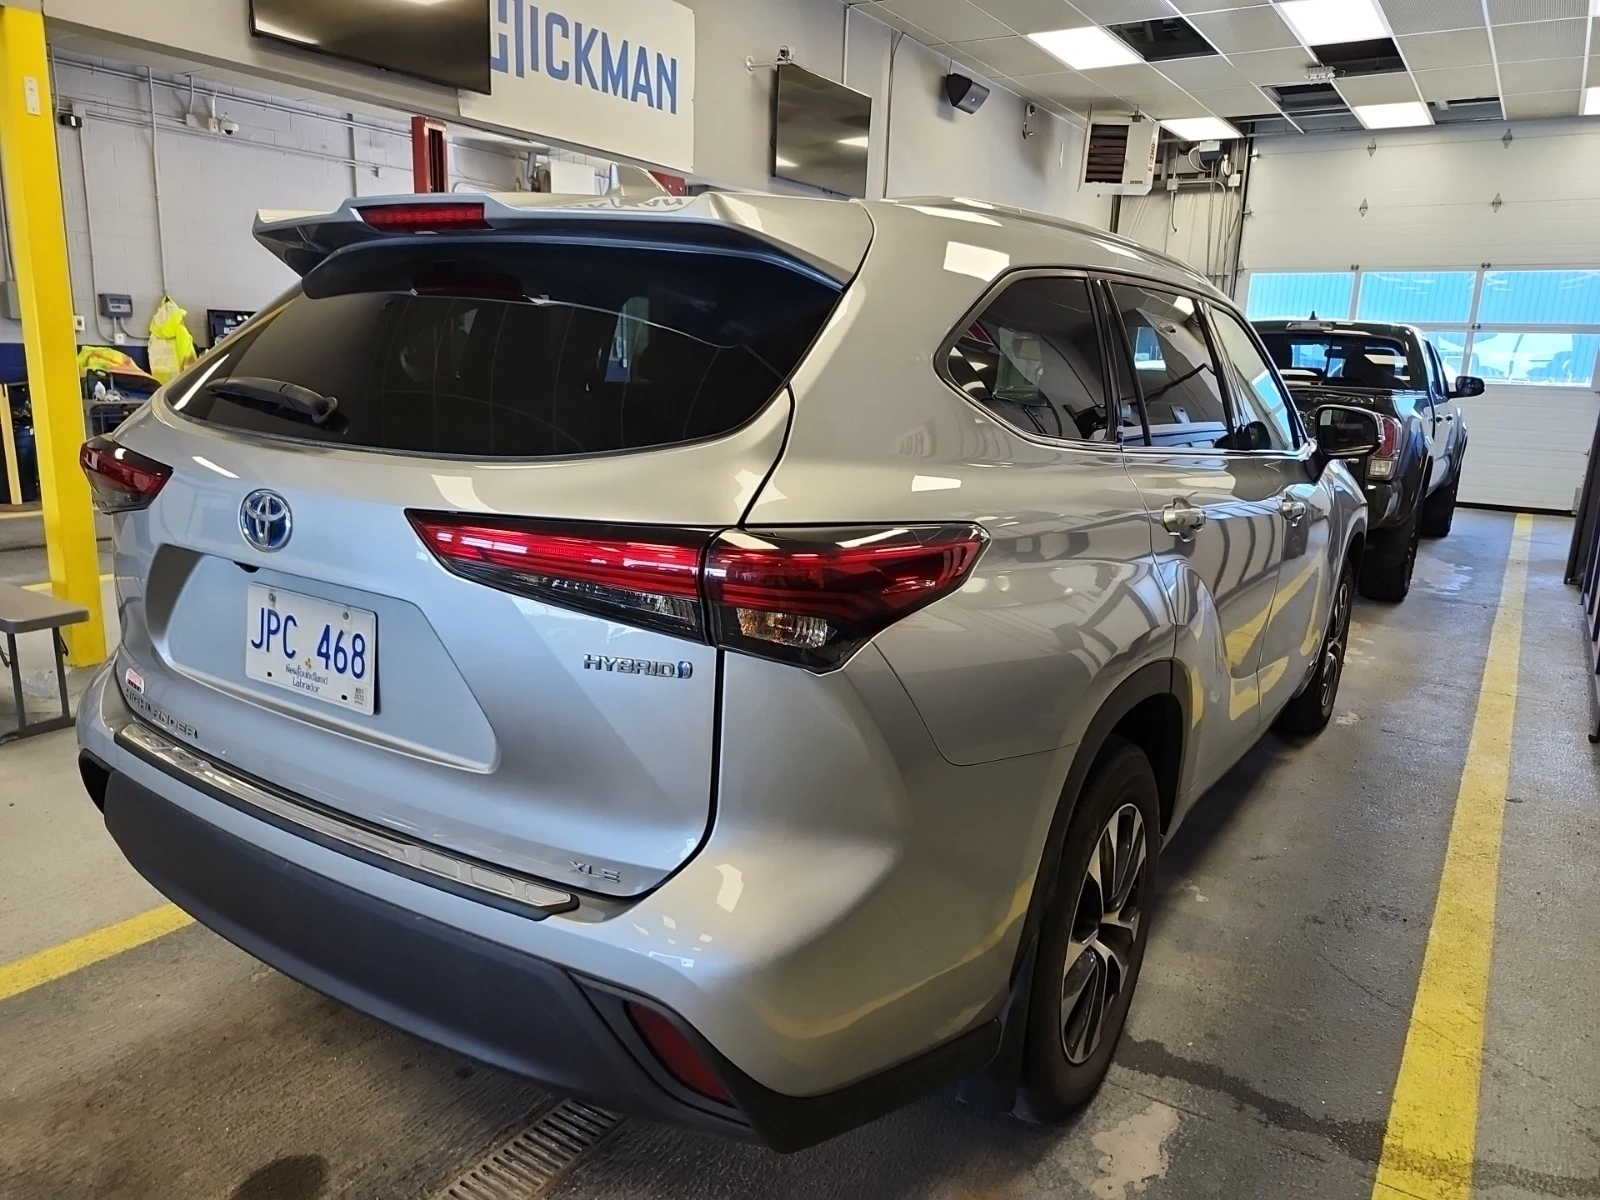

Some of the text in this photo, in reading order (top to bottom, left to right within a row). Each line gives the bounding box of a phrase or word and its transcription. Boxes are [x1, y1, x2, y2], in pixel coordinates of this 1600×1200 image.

[251, 607, 366, 680] JPC 468
[285, 663, 329, 686] Newfoundland
[583, 653, 676, 678] HYBRID
[292, 676, 321, 694] Labrador
[125, 687, 199, 740] HIGHLANDER
[569, 860, 621, 883] XLE
